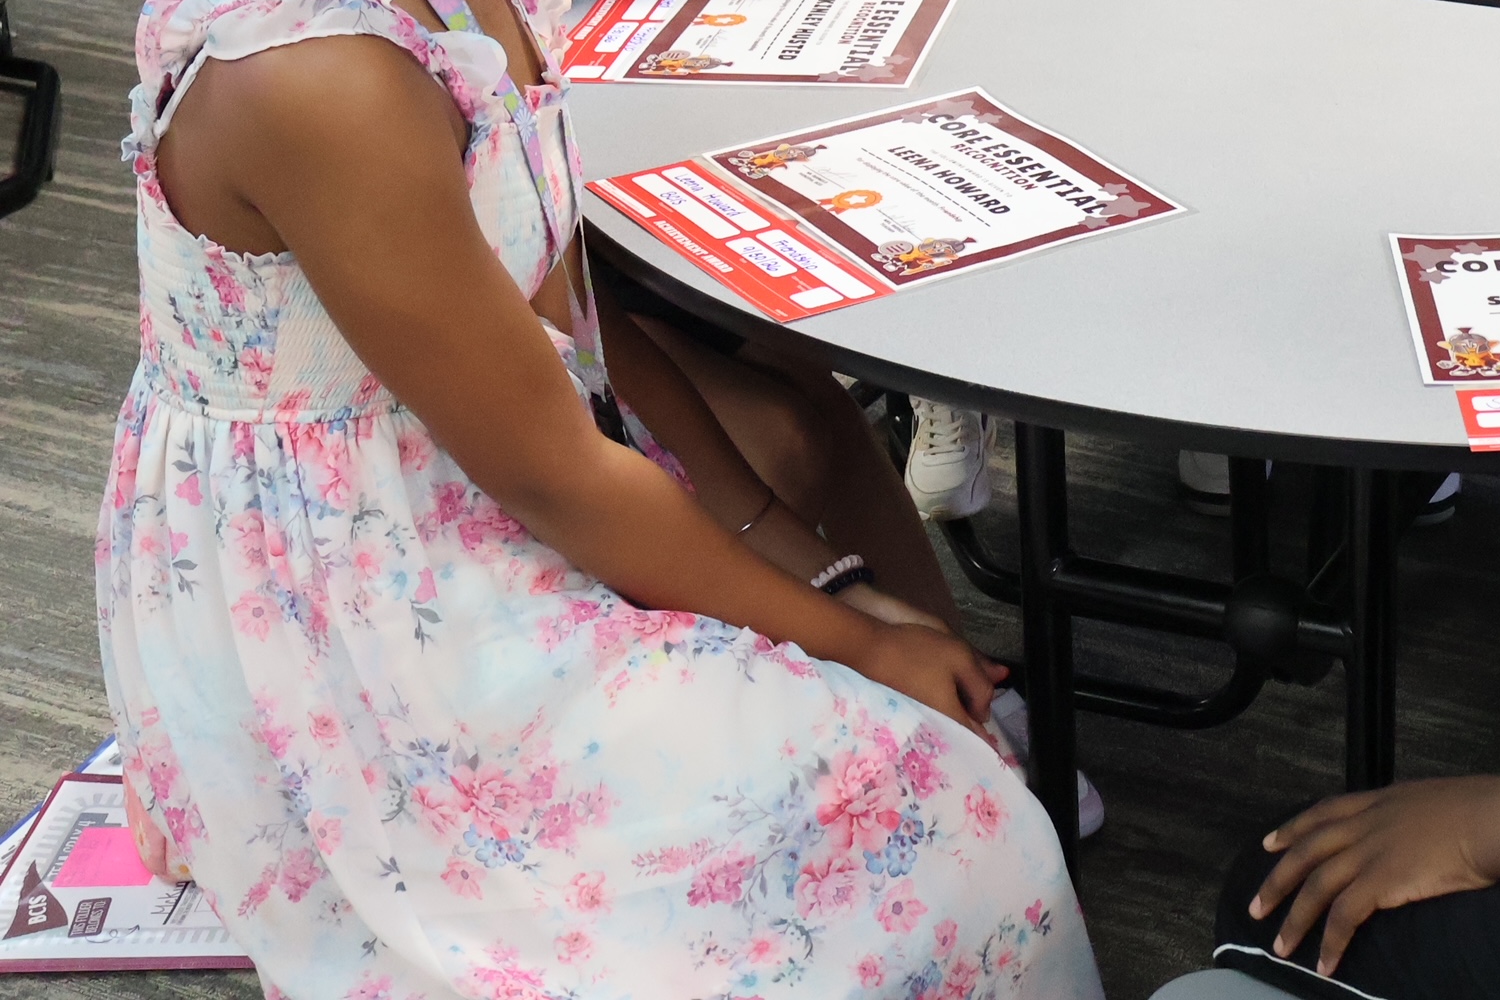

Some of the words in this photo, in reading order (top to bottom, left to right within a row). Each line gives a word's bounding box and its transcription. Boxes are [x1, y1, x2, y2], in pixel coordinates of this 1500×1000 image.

[778, 28, 815, 60] HUSTED
[837, 2, 877, 45] RECOGNITION
[839, 9, 900, 71] ESSENTIAL
[887, 145, 941, 172] LEENA
[932, 169, 1011, 215] HOWARD
[927, 113, 994, 145] CORE
[981, 143, 1108, 214] ESSENTIAL
[951, 143, 1039, 191] RECOGNITION
[674, 173, 704, 193] Leena
[704, 192, 747, 218] Howard
[653, 220, 709, 256] ACHIEVEMENT
[701, 252, 734, 274] AWARD
[28, 894, 48, 925] BCIS
[70, 922, 86, 937] THIS
[75, 901, 93, 923] FOLDER
[85, 909, 104, 934] BELONGS
